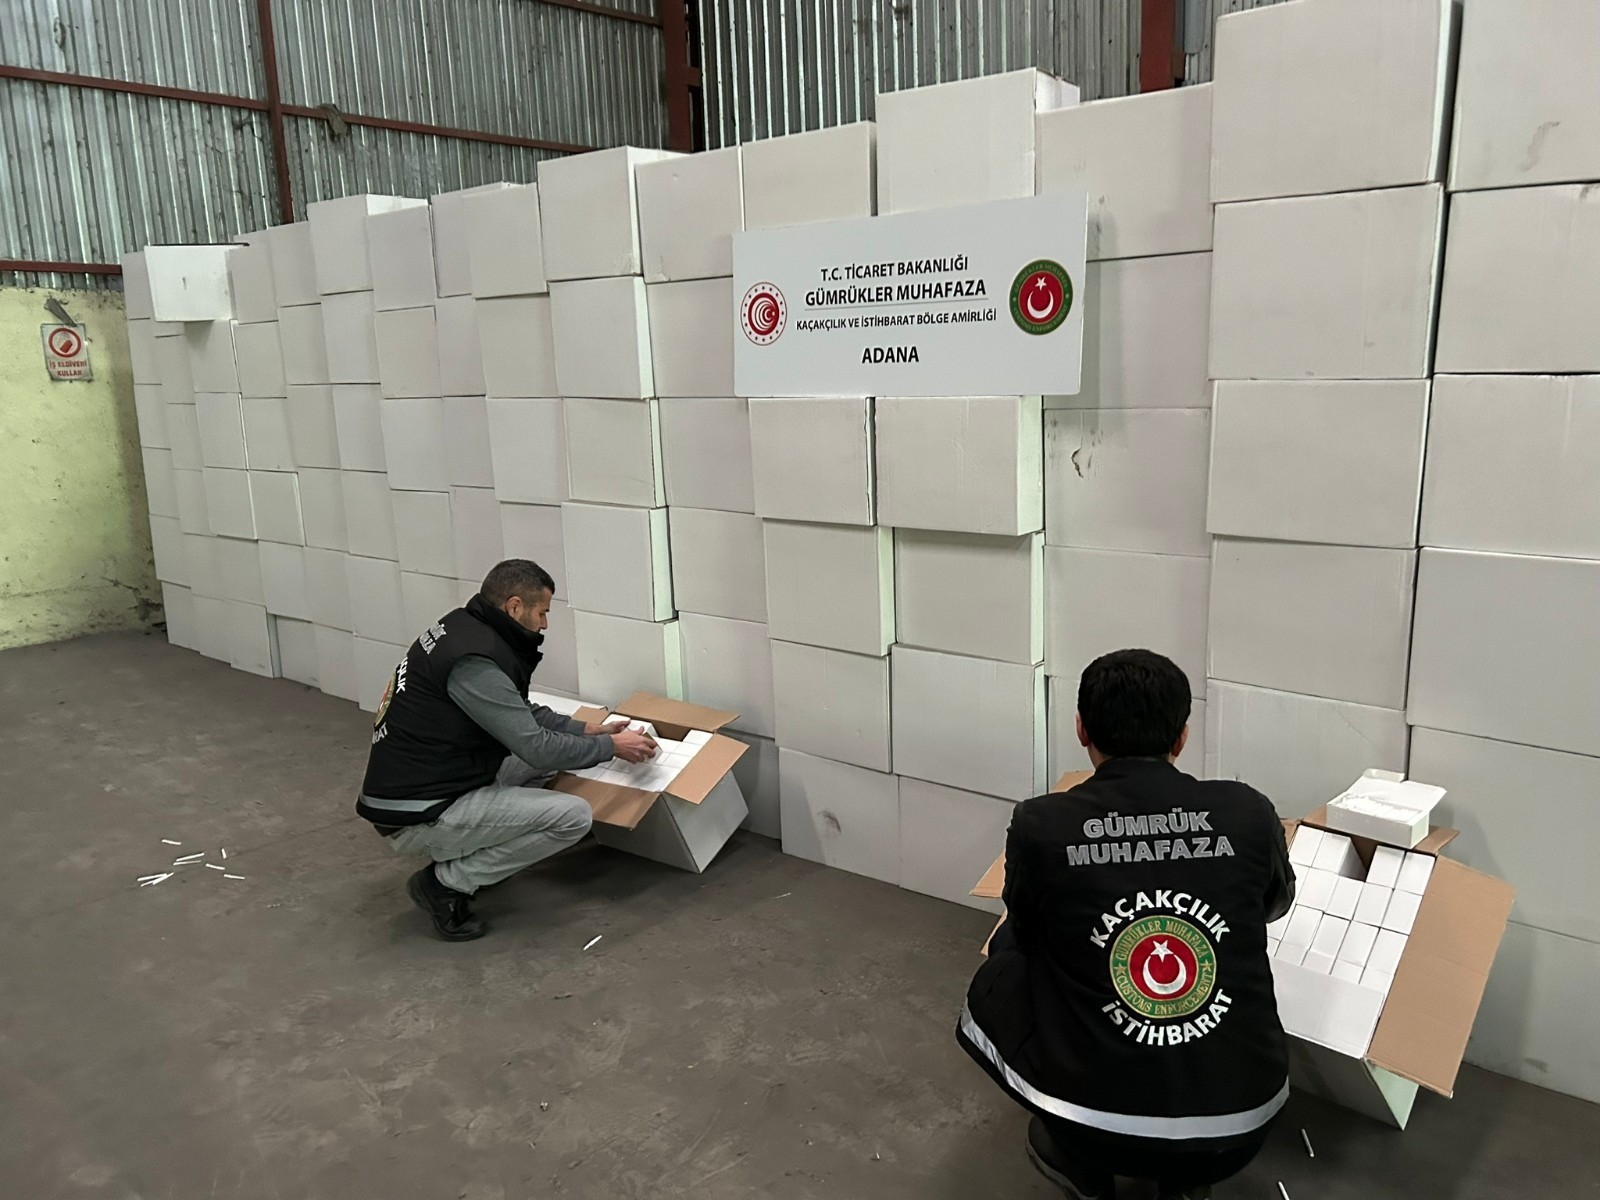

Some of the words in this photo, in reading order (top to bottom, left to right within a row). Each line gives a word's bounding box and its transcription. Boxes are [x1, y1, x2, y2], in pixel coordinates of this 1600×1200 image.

[821, 268, 842, 281] T.C.
[844, 262, 895, 280] TİCARET
[897, 254, 968, 276] BAKANLIĞI
[805, 285, 893, 306] GÜMRÜKLER
[896, 279, 986, 301] MUHAFAZA
[796, 319, 847, 332] KAÇAKÇILIK
[848, 318, 860, 328] VE
[861, 314, 915, 328] İSTİHBARAT
[917, 312, 949, 325] BÖLGE
[951, 308, 996, 323] AMİRLİĞİ
[861, 346, 919, 364] ADANA
[1083, 807, 1213, 838] GÜMRÜK
[1066, 836, 1235, 866] MUHAFAZA
[1090, 889, 1231, 949] KAÇAKÇILIK
[1165, 920, 1209, 958] MUHAFAZA
[1116, 975, 1153, 1013] CUSTOMS
[1154, 971, 1213, 1015] ENFORCEMENT
[1101, 988, 1233, 1047] İSTİHBARAT
